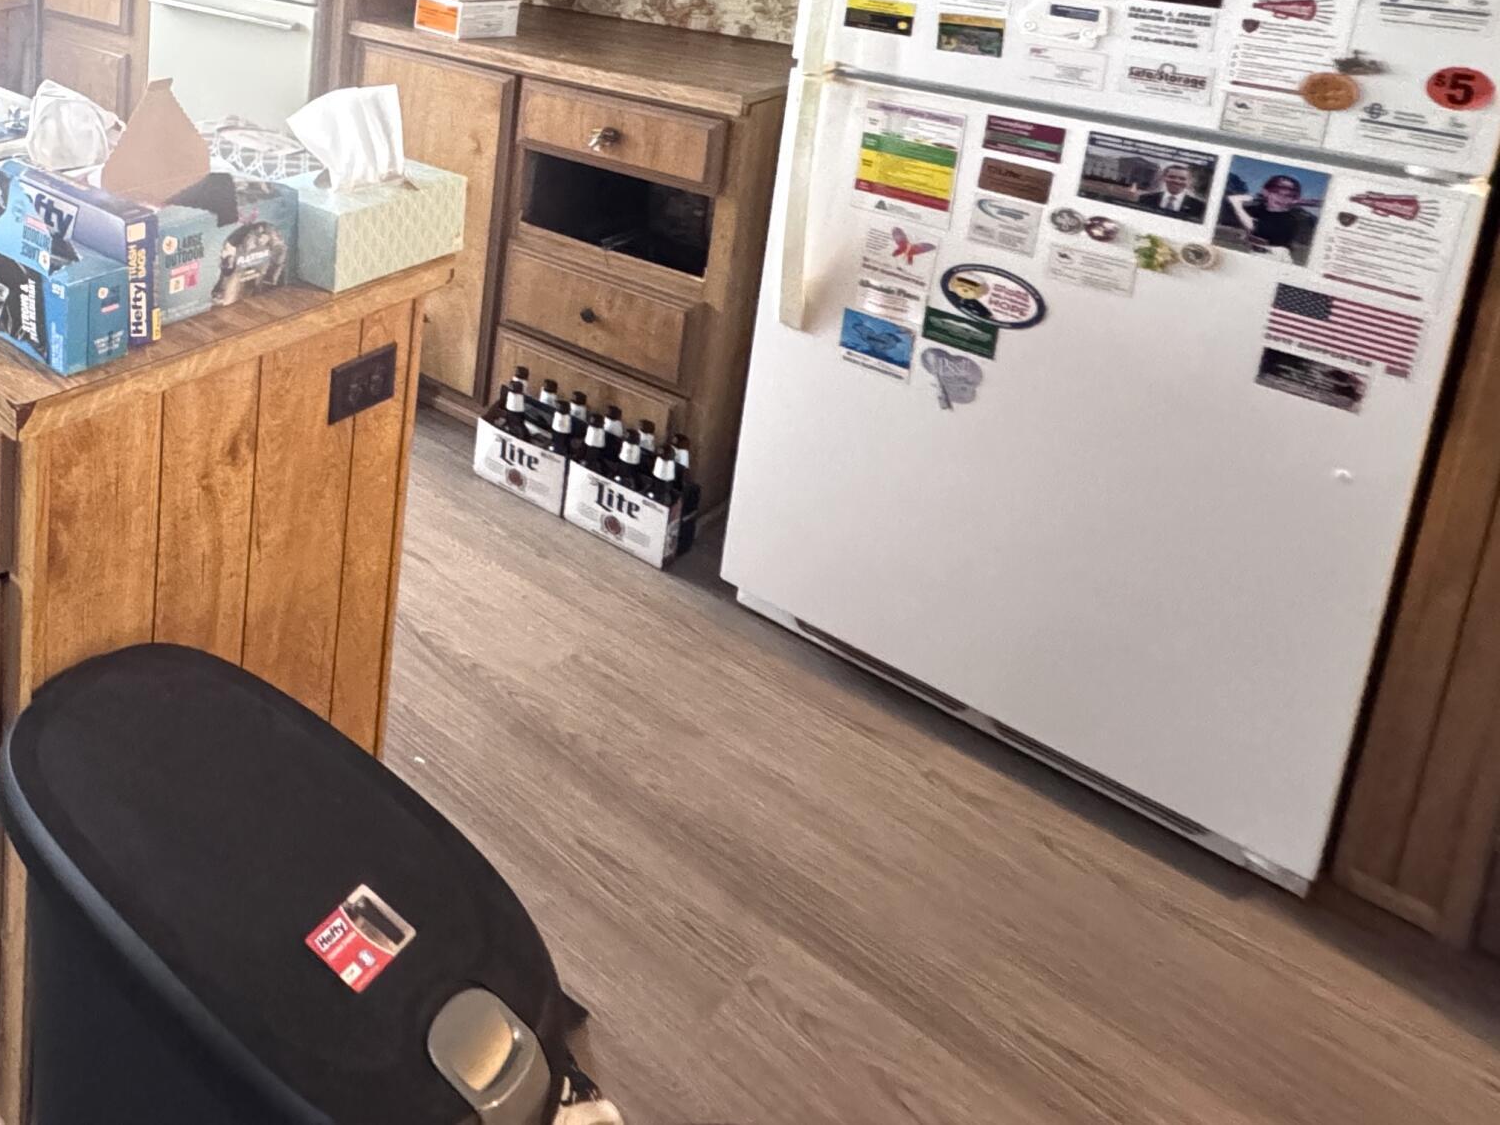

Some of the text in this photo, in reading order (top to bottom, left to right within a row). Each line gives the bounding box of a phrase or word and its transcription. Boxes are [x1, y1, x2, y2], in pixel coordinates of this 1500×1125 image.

[1434, 72, 1476, 105] $5
[131, 284, 146, 335] Hefty
[494, 434, 540, 472] Lite
[587, 473, 641, 520] Lite
[318, 923, 347, 949] Hefty
